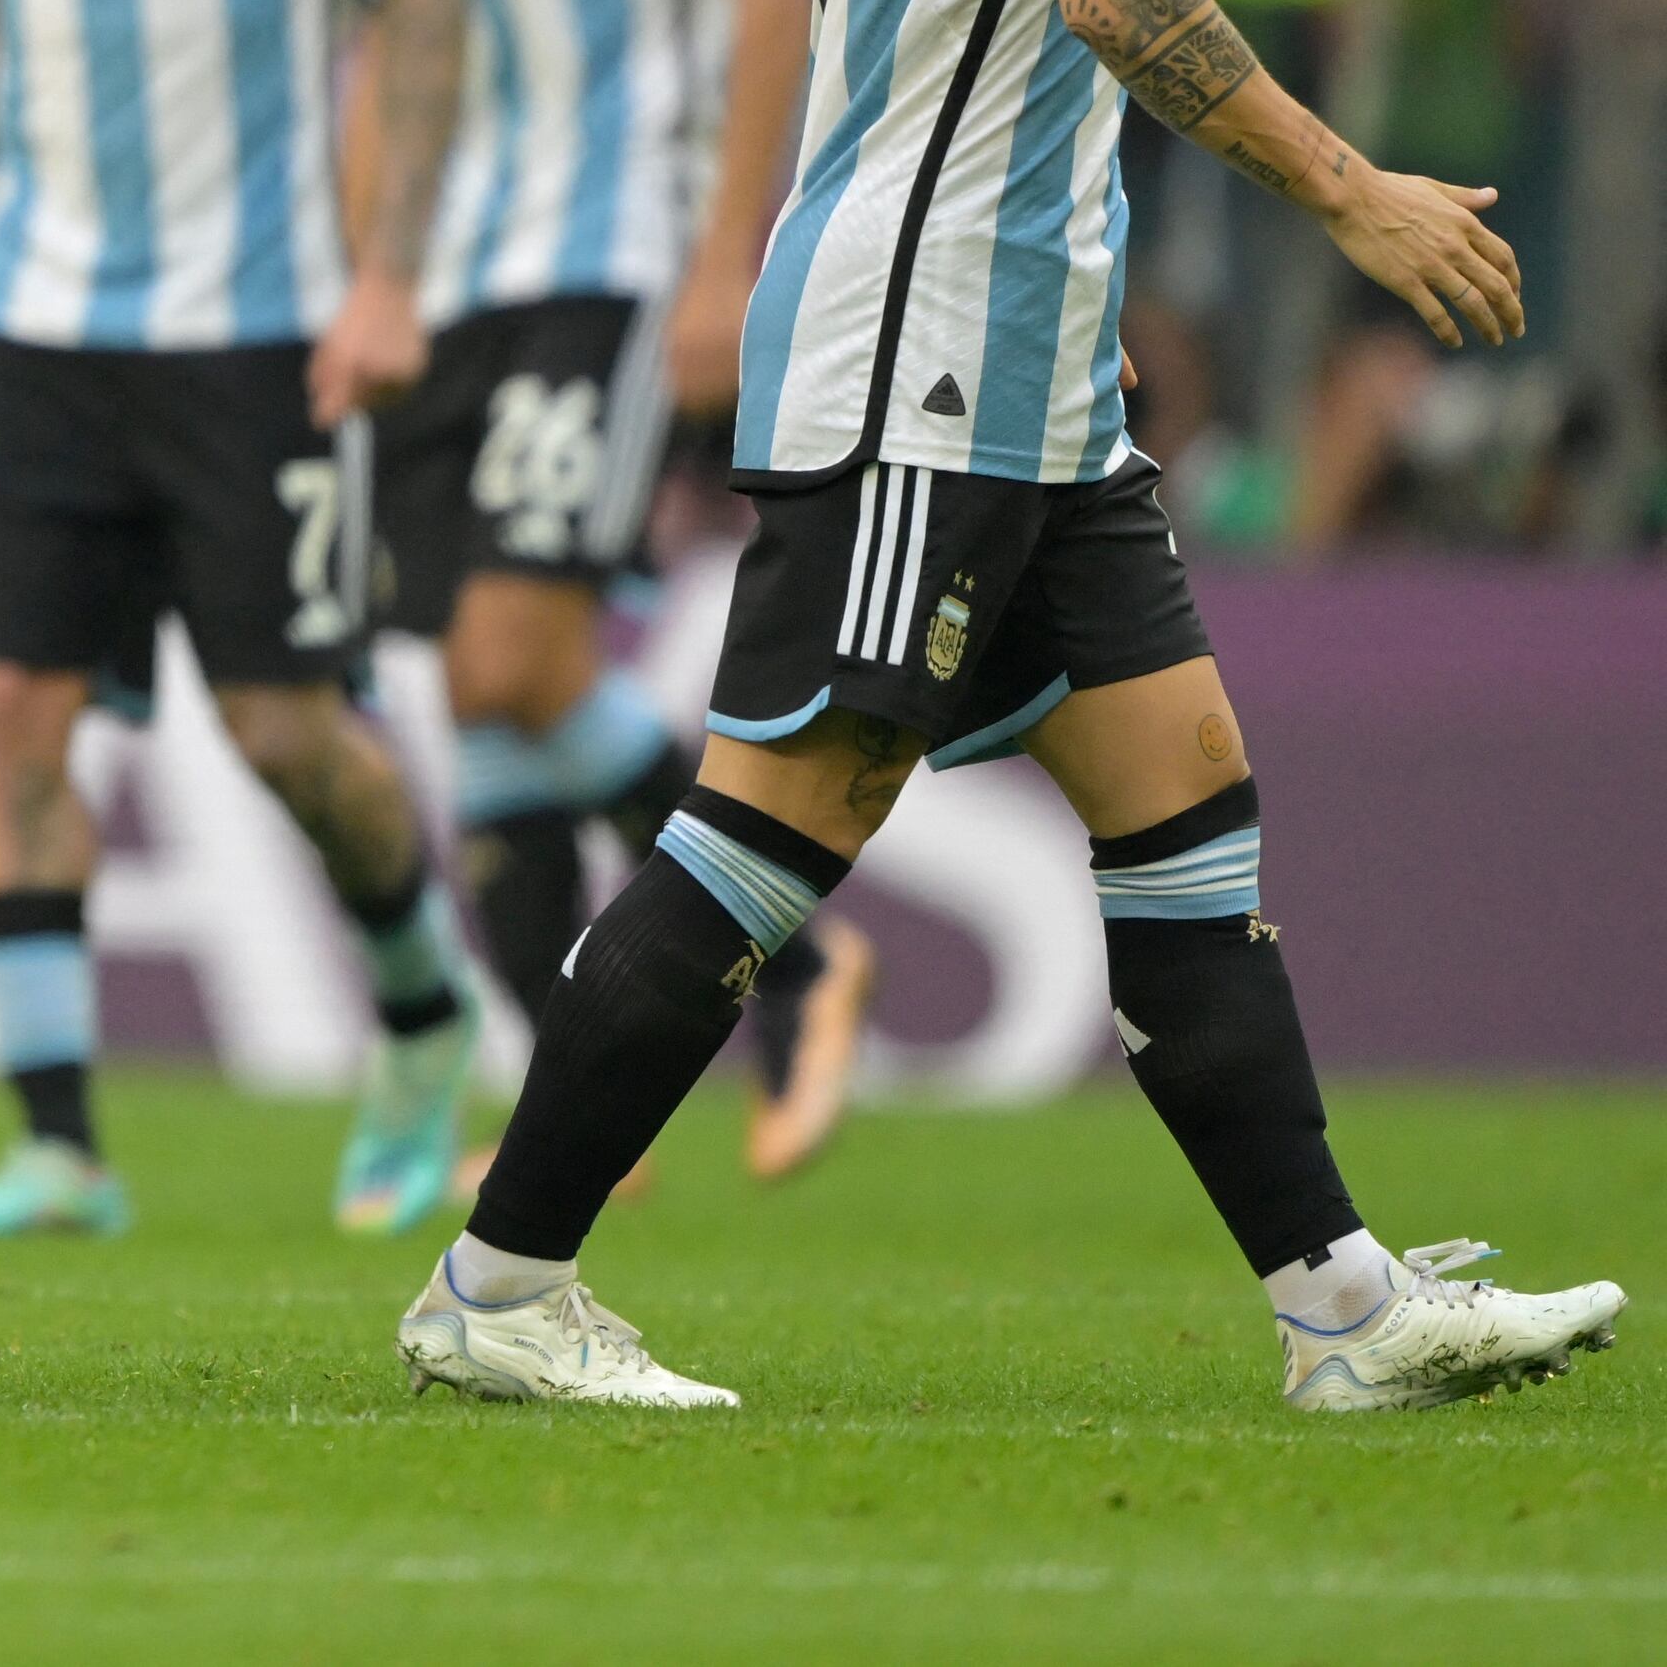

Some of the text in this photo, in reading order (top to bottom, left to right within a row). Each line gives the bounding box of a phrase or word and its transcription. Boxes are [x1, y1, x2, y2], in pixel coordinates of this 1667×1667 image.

[469, 371, 602, 516] 26
[274, 456, 338, 602] 7
[1385, 1307, 1409, 1334] COPA
